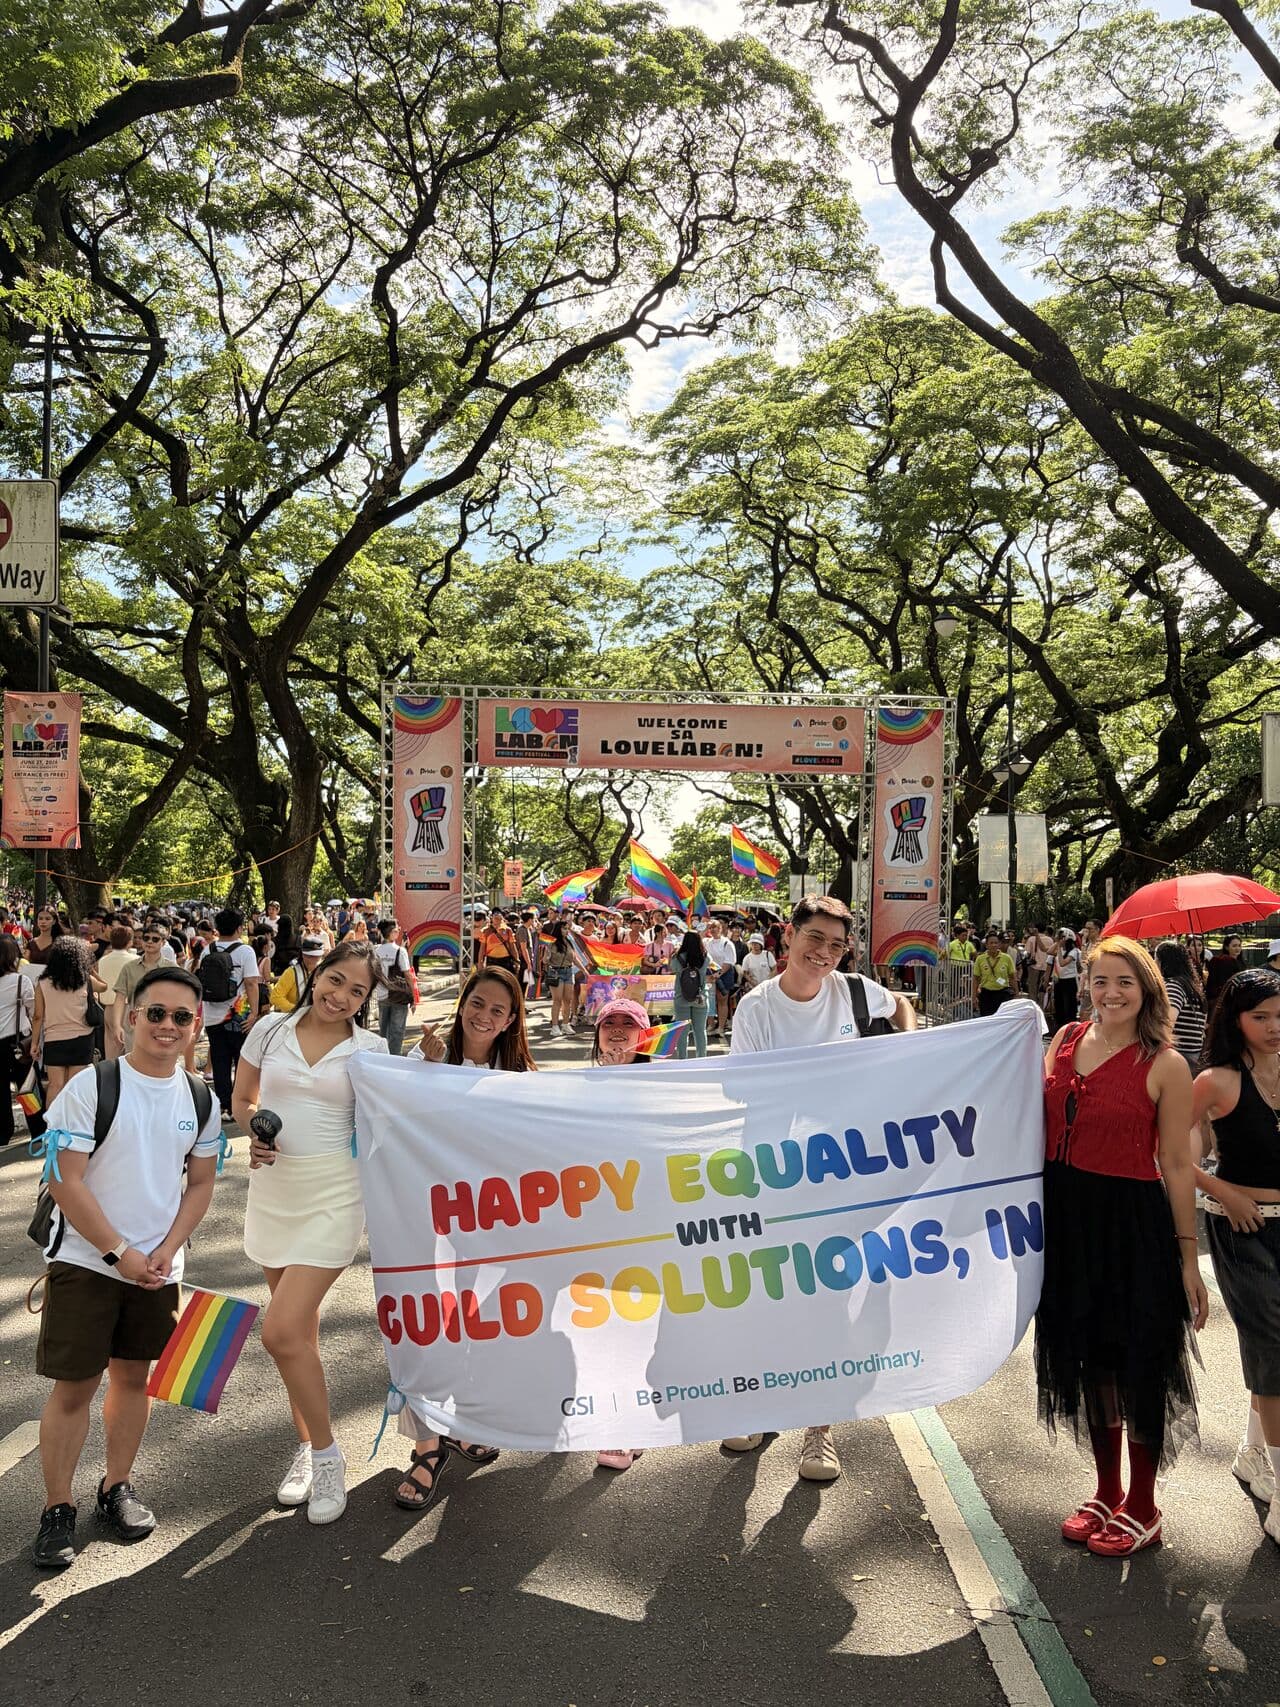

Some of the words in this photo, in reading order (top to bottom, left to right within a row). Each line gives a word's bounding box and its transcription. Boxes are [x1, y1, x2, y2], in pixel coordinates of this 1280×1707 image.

[0, 563, 45, 595] Way
[496, 706, 579, 733] LOVE
[637, 718, 728, 729] WELCOME
[809, 719, 827, 727] Pride
[671, 730, 693, 740] SA
[840, 1024, 853, 1035] GSI
[177, 1120, 195, 1131] GSI
[431, 1159, 641, 1236] HAPPY
[666, 1106, 977, 1203] EQUALITY
[676, 1212, 763, 1246] WITH
[377, 1282, 544, 1347] GUILD
[570, 1219, 970, 1329] SOLUTIONS,
[985, 1201, 1044, 1261] IN
[561, 1396, 594, 1417] GSI
[637, 1389, 662, 1407] Be
[666, 1378, 729, 1402] Proud.
[733, 1377, 760, 1394] Be
[763, 1361, 838, 1389] Beyond
[841, 1349, 925, 1377] Ordinary.
